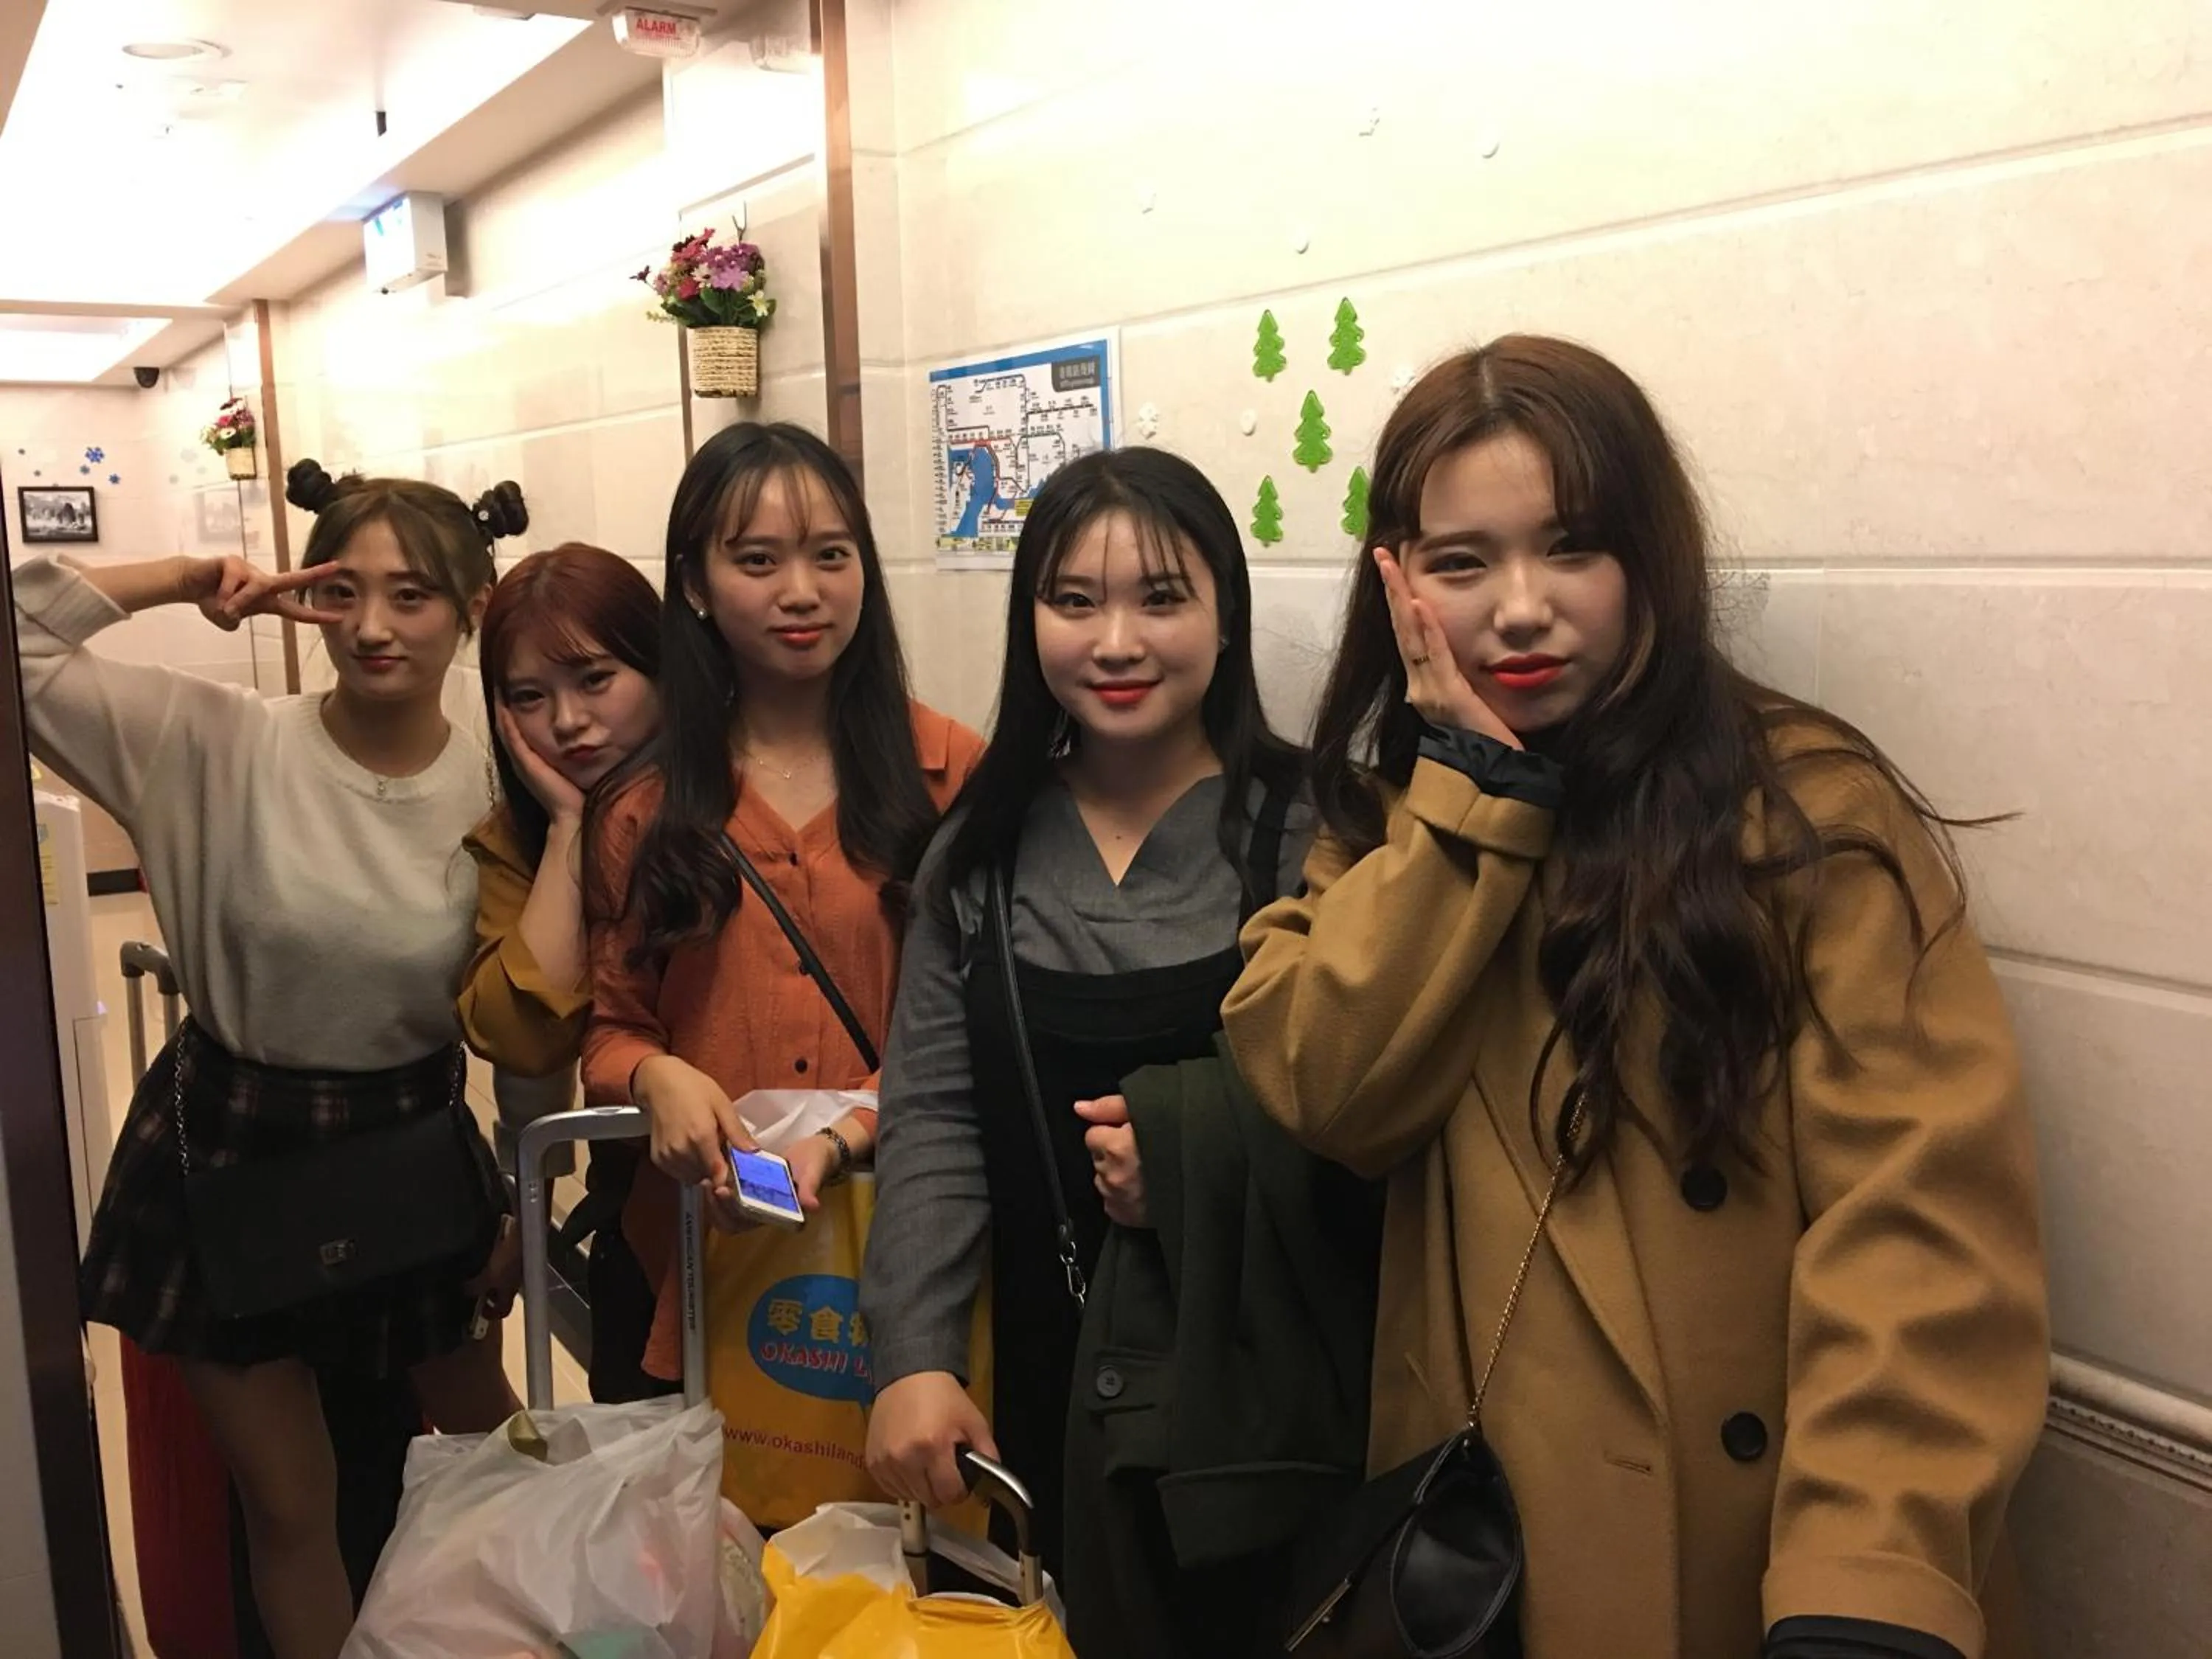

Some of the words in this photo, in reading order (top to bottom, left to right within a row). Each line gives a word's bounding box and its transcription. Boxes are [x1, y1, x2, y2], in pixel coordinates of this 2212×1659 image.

[636, 18, 677, 34] ALARM
[761, 1342, 849, 1374] OKASHI
[853, 1355, 872, 1383] L
